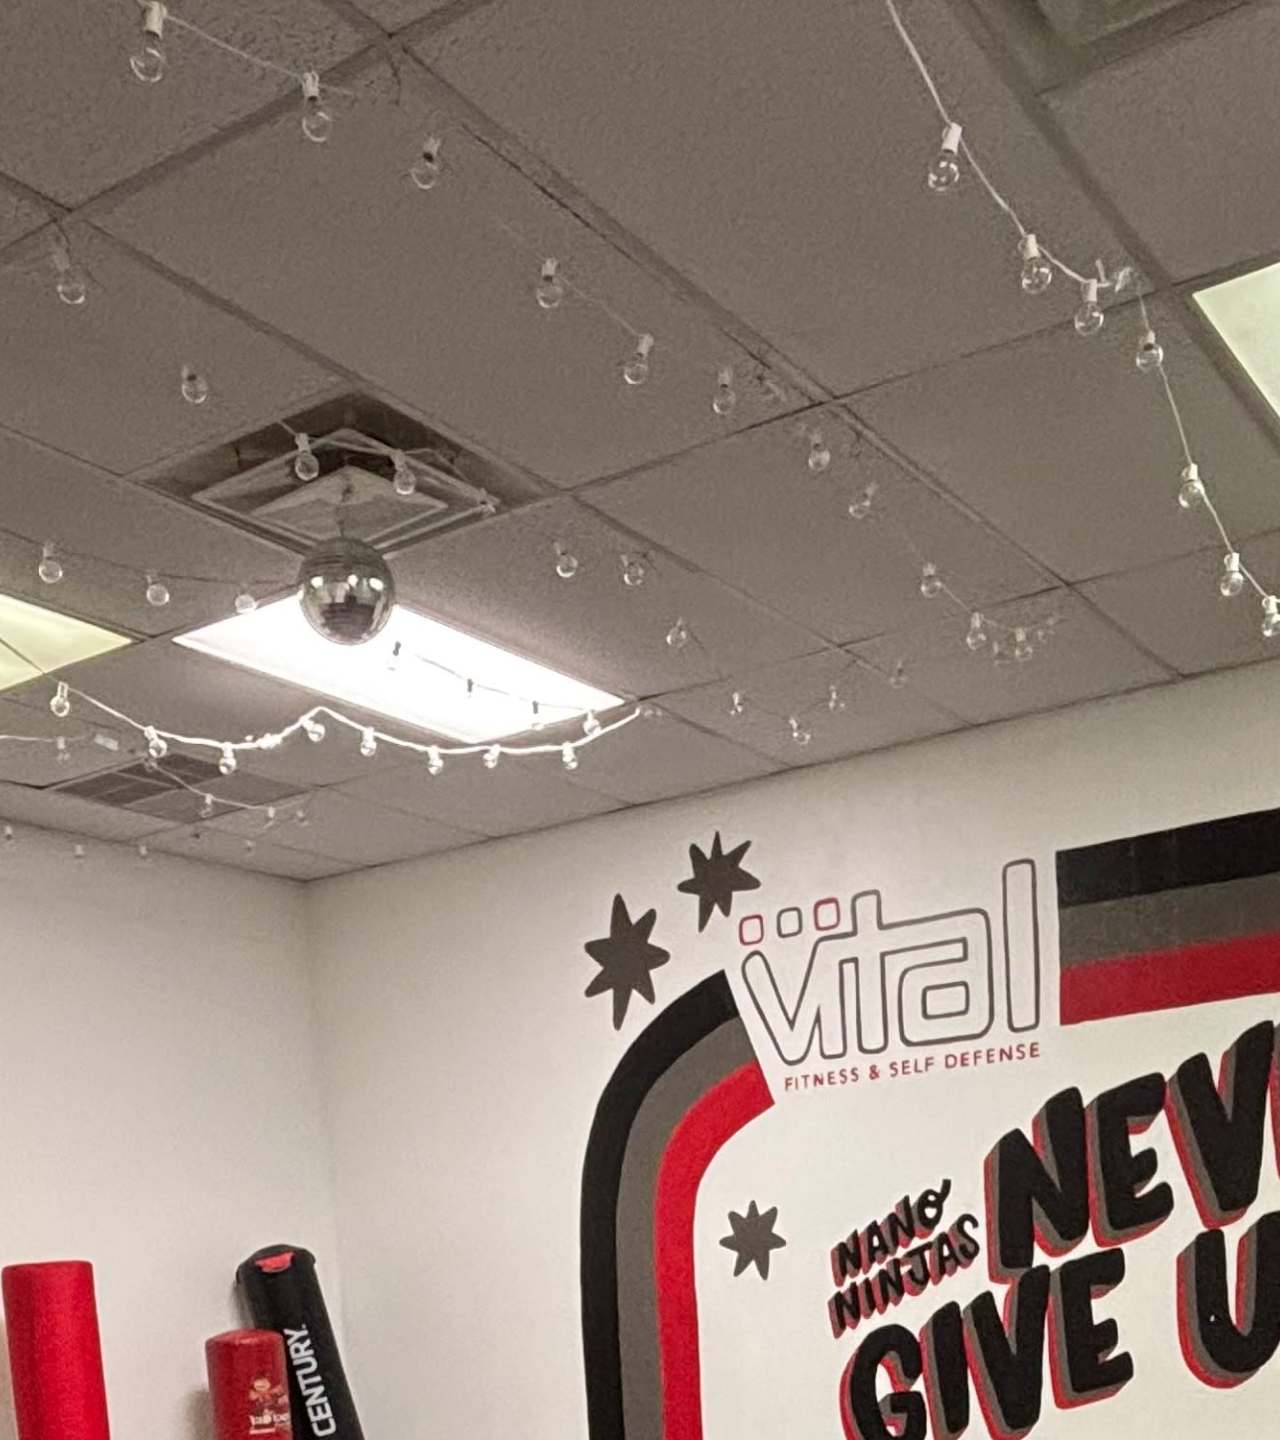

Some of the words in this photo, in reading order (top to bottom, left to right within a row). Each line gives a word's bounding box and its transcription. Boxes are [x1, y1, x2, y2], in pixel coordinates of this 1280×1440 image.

[783, 1066, 860, 1092] FITNESS
[869, 1064, 881, 1081] &
[889, 1055, 935, 1078] SELF
[944, 1041, 1041, 1069] DEFENSE
[827, 1213, 980, 1339] NINJAS
[830, 1178, 952, 1287] NANO
